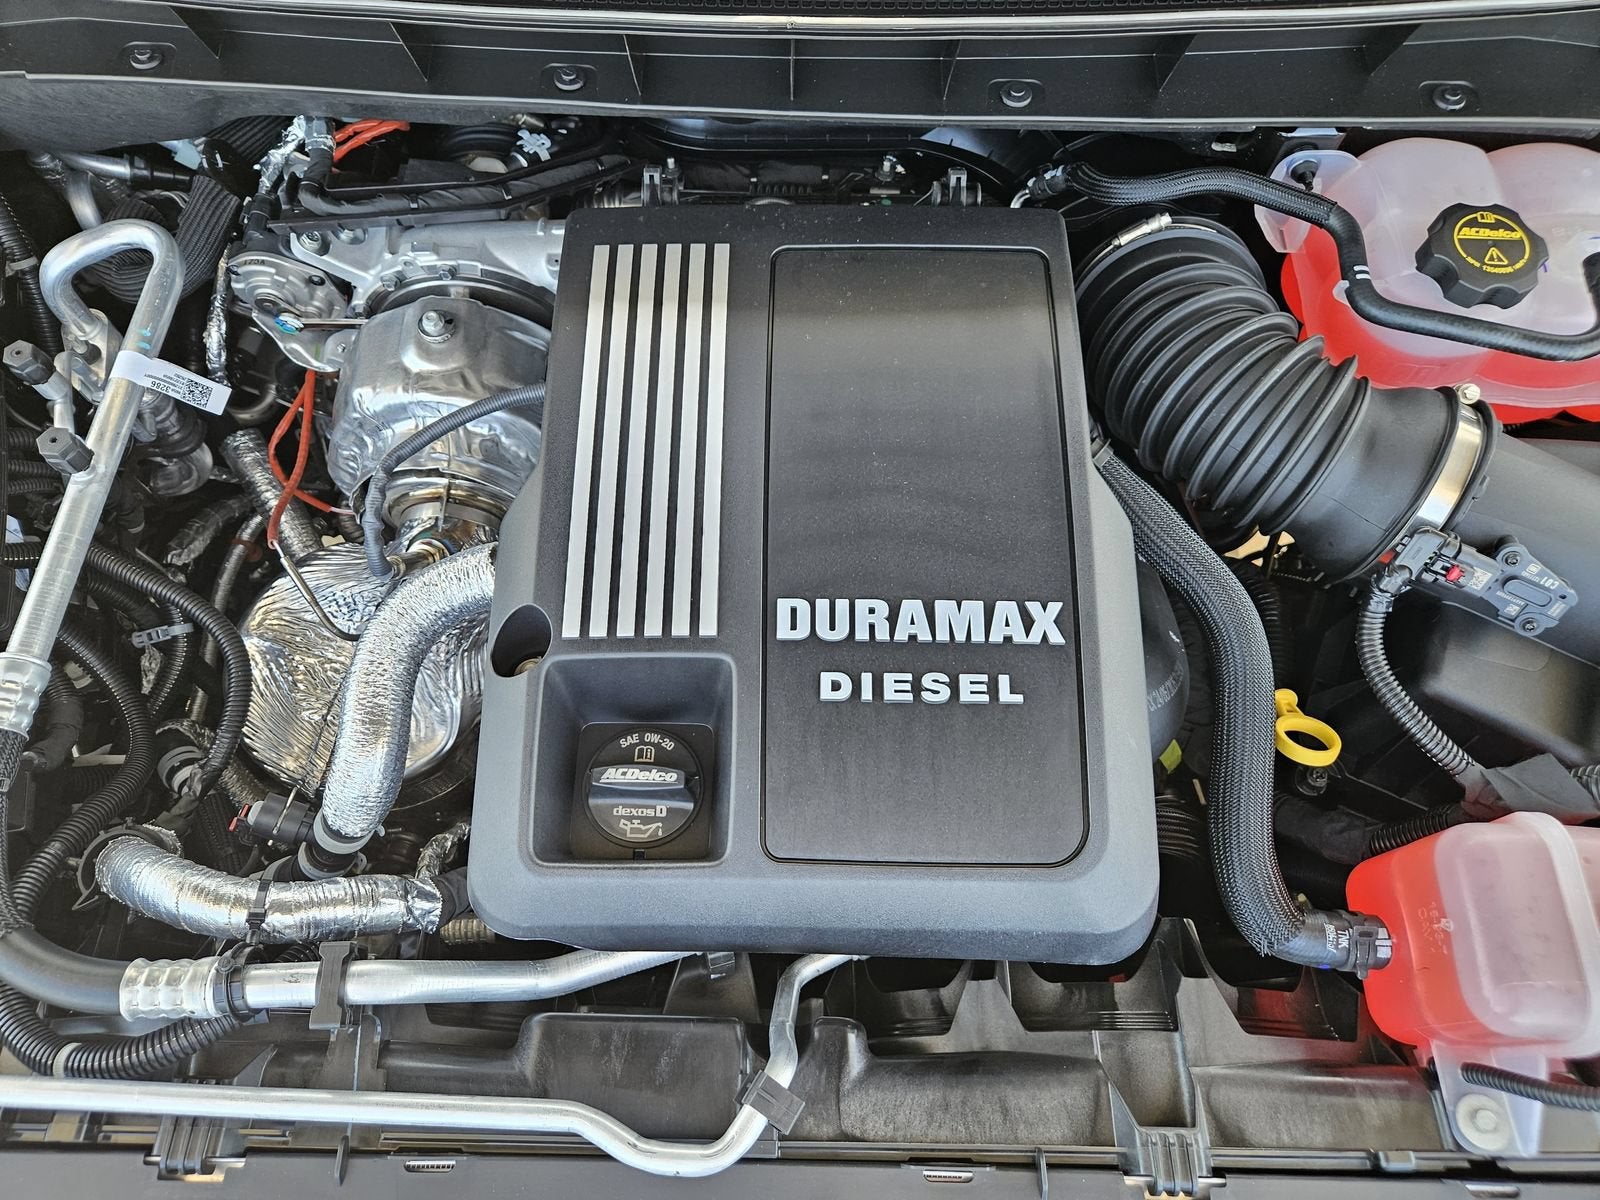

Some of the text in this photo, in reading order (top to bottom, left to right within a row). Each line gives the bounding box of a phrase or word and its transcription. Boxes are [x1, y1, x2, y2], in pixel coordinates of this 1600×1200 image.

[1459, 227, 1522, 239] ACDelco
[151, 380, 171, 393] 3286
[776, 598, 1066, 645] DURAMAX
[819, 671, 1024, 704] DIESEL
[619, 732, 675, 751] SAE 0W-20
[600, 768, 678, 782] ACDelco
[1337, 930, 1350, 948] TNK
